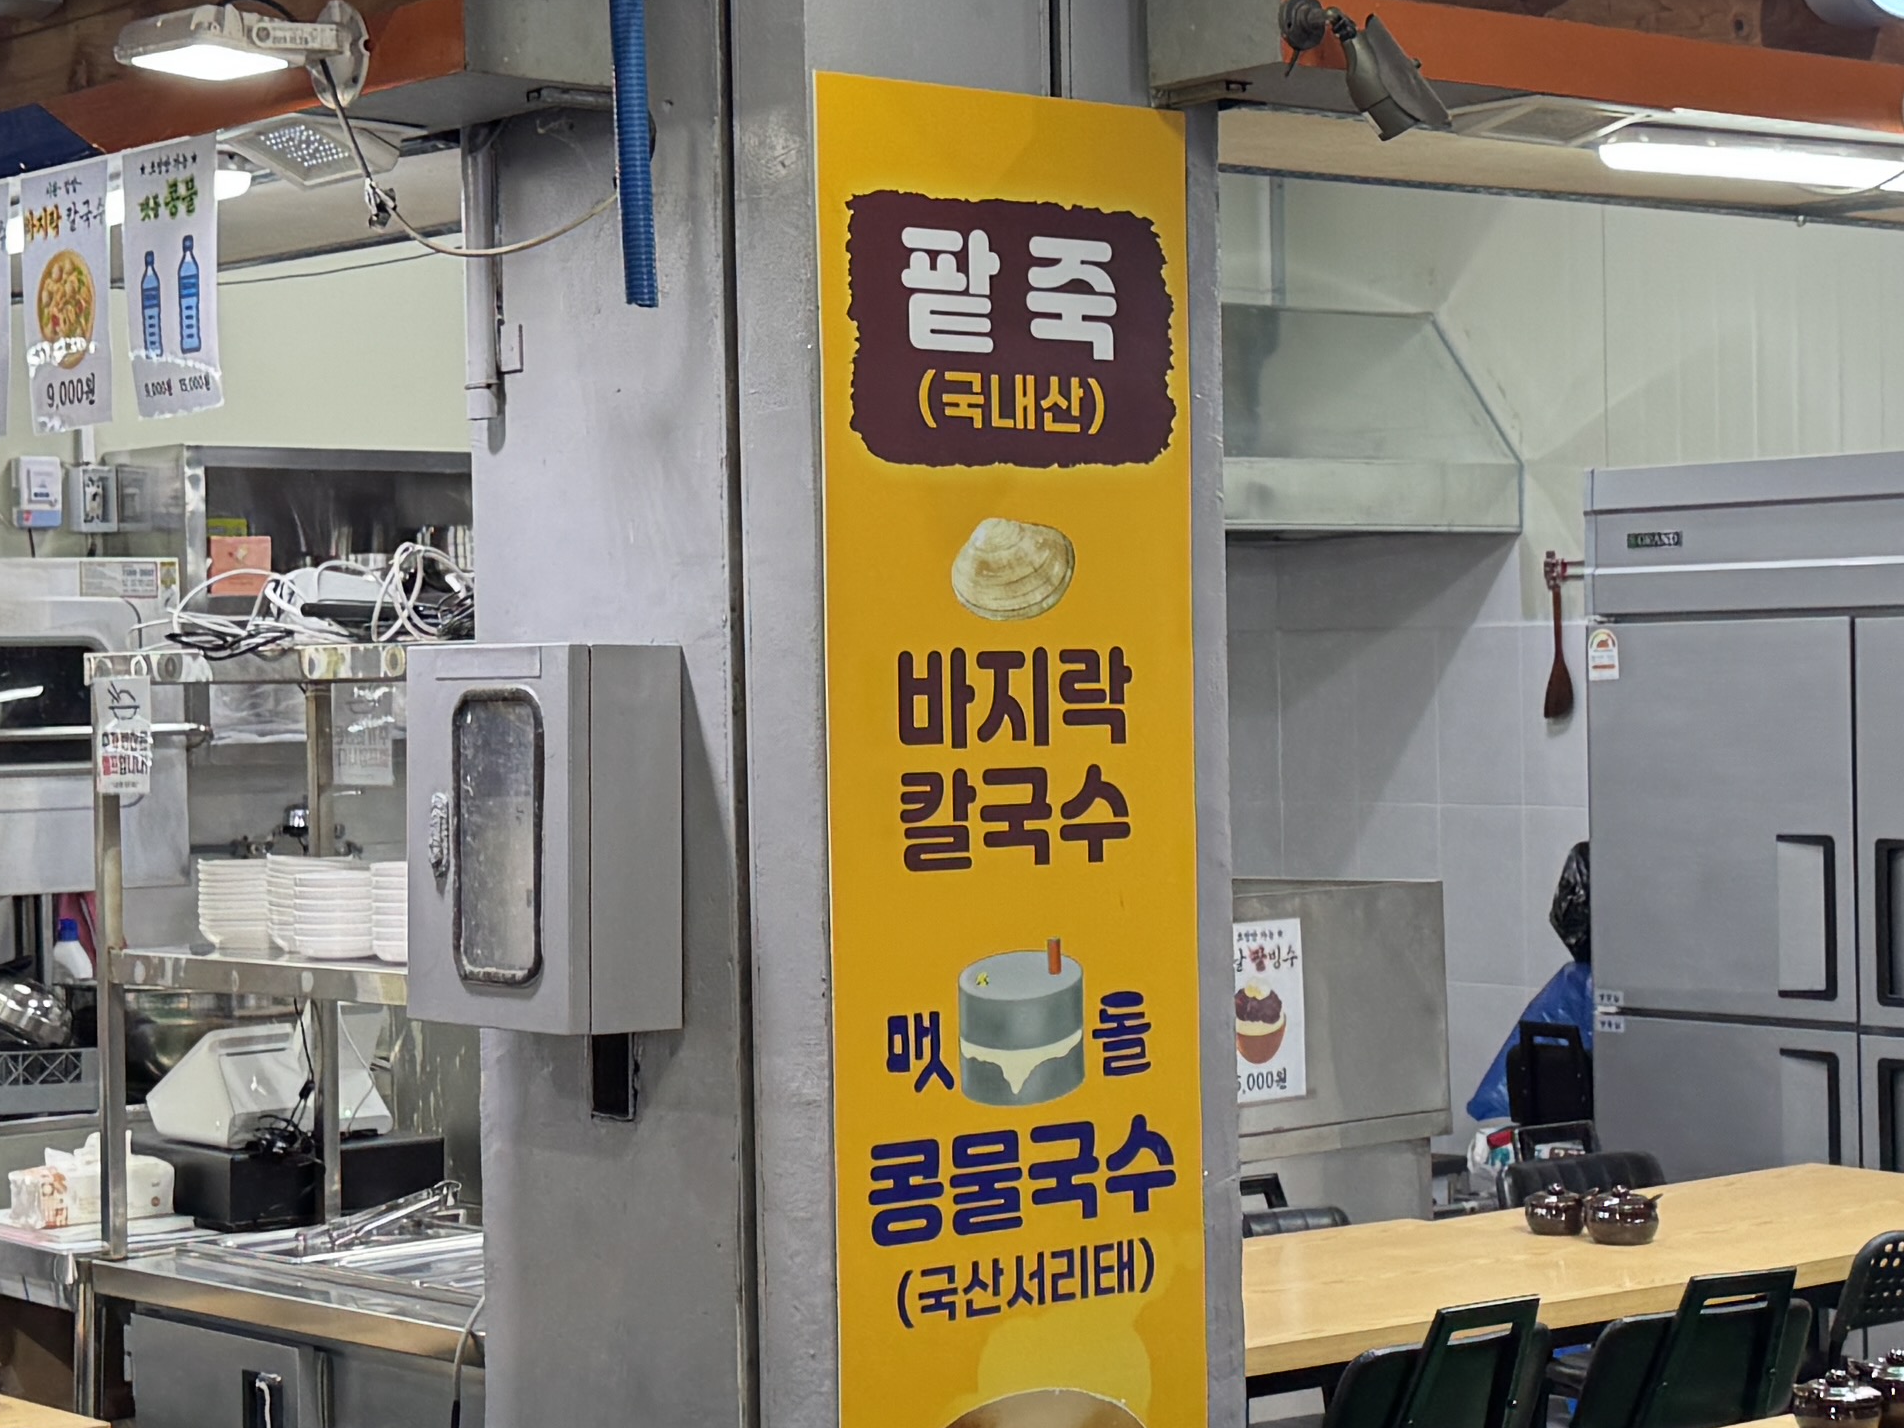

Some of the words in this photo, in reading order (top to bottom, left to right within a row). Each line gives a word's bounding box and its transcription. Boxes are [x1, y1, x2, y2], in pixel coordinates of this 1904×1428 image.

[47, 372, 96, 410] 9,000원
[919, 369, 1106, 435] (국내산)
[897, 645, 1134, 749] 바지락
[900, 764, 1132, 872] 칼국수
[868, 1114, 1178, 1247] 콩물국수
[897, 1236, 1156, 1329] (국산서리태)
